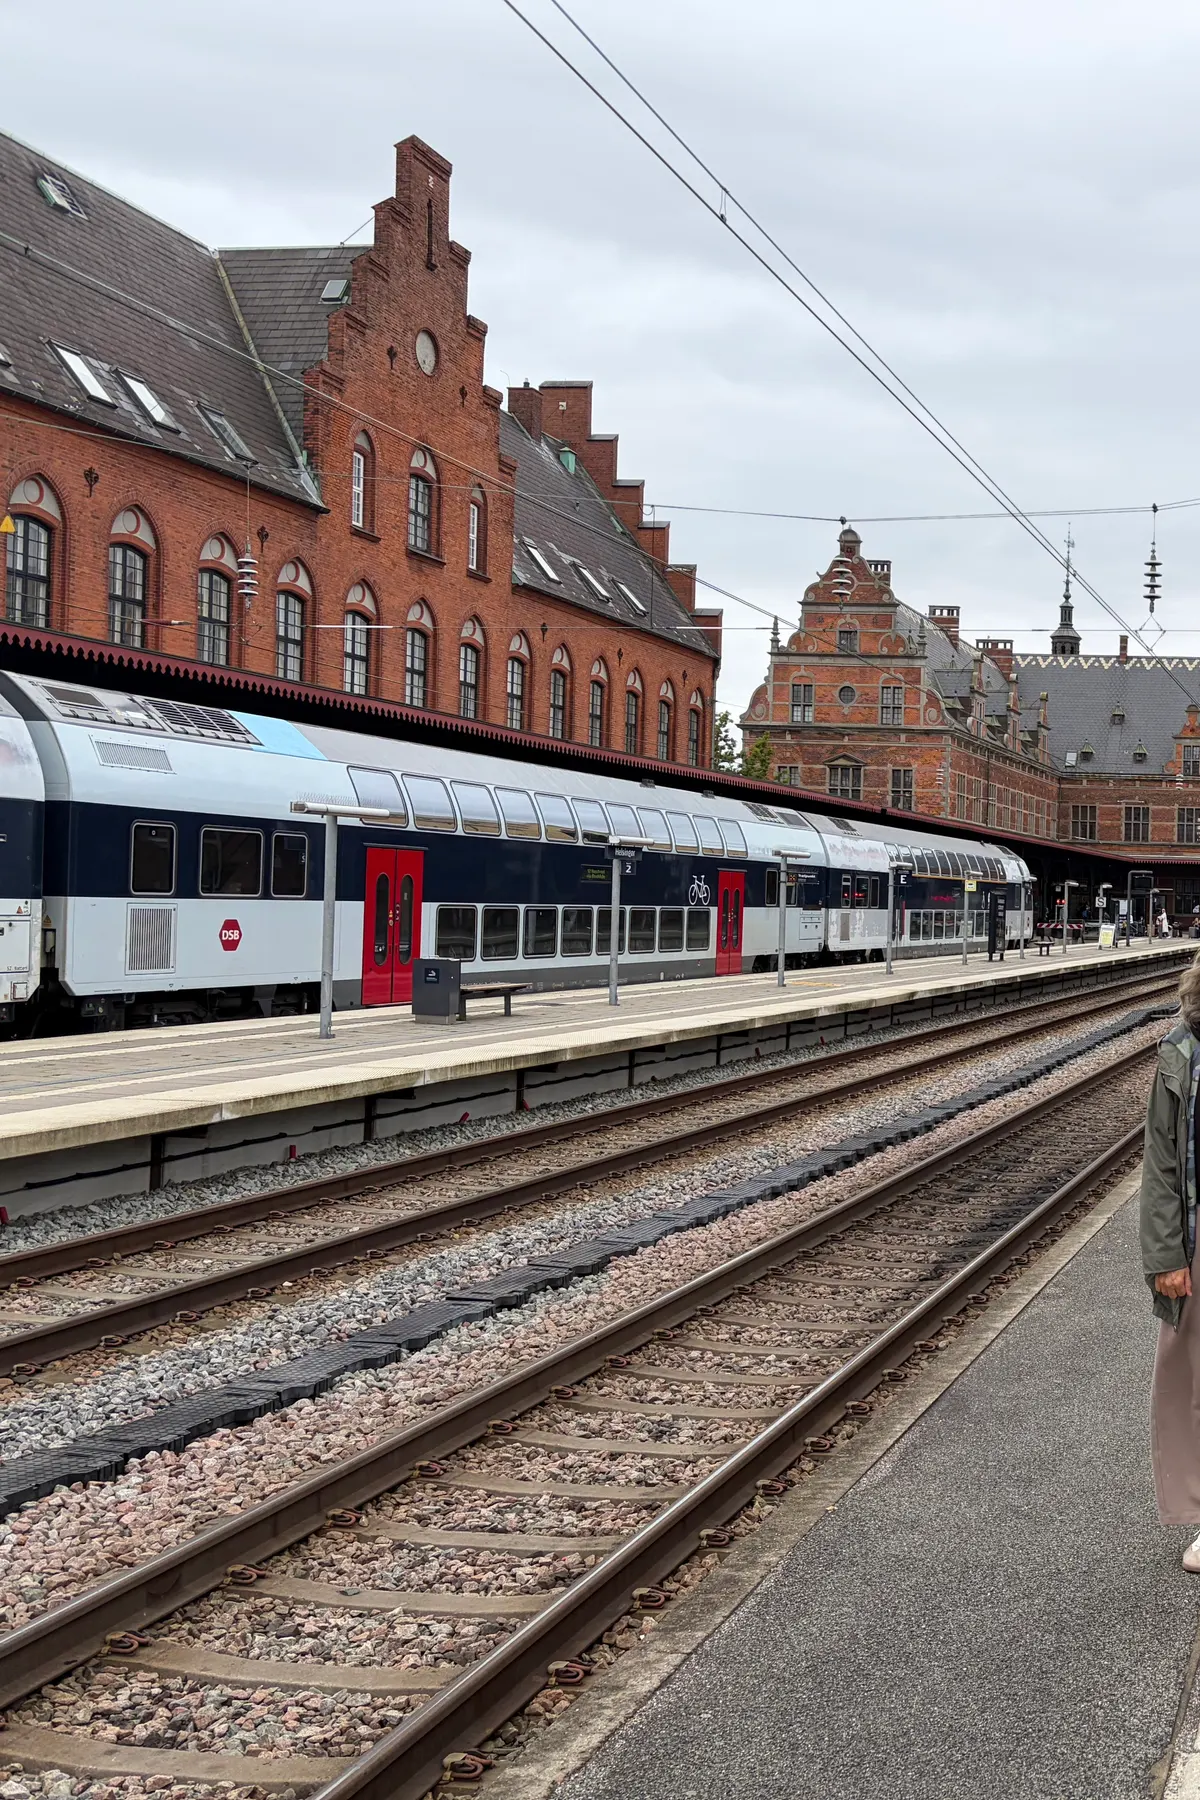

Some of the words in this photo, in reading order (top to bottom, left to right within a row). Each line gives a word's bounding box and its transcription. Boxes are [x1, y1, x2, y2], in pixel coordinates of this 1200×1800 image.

[625, 865, 631, 873] 2
[900, 874, 907, 884] E
[1097, 897, 1105, 907] S
[221, 930, 240, 940] DSB
